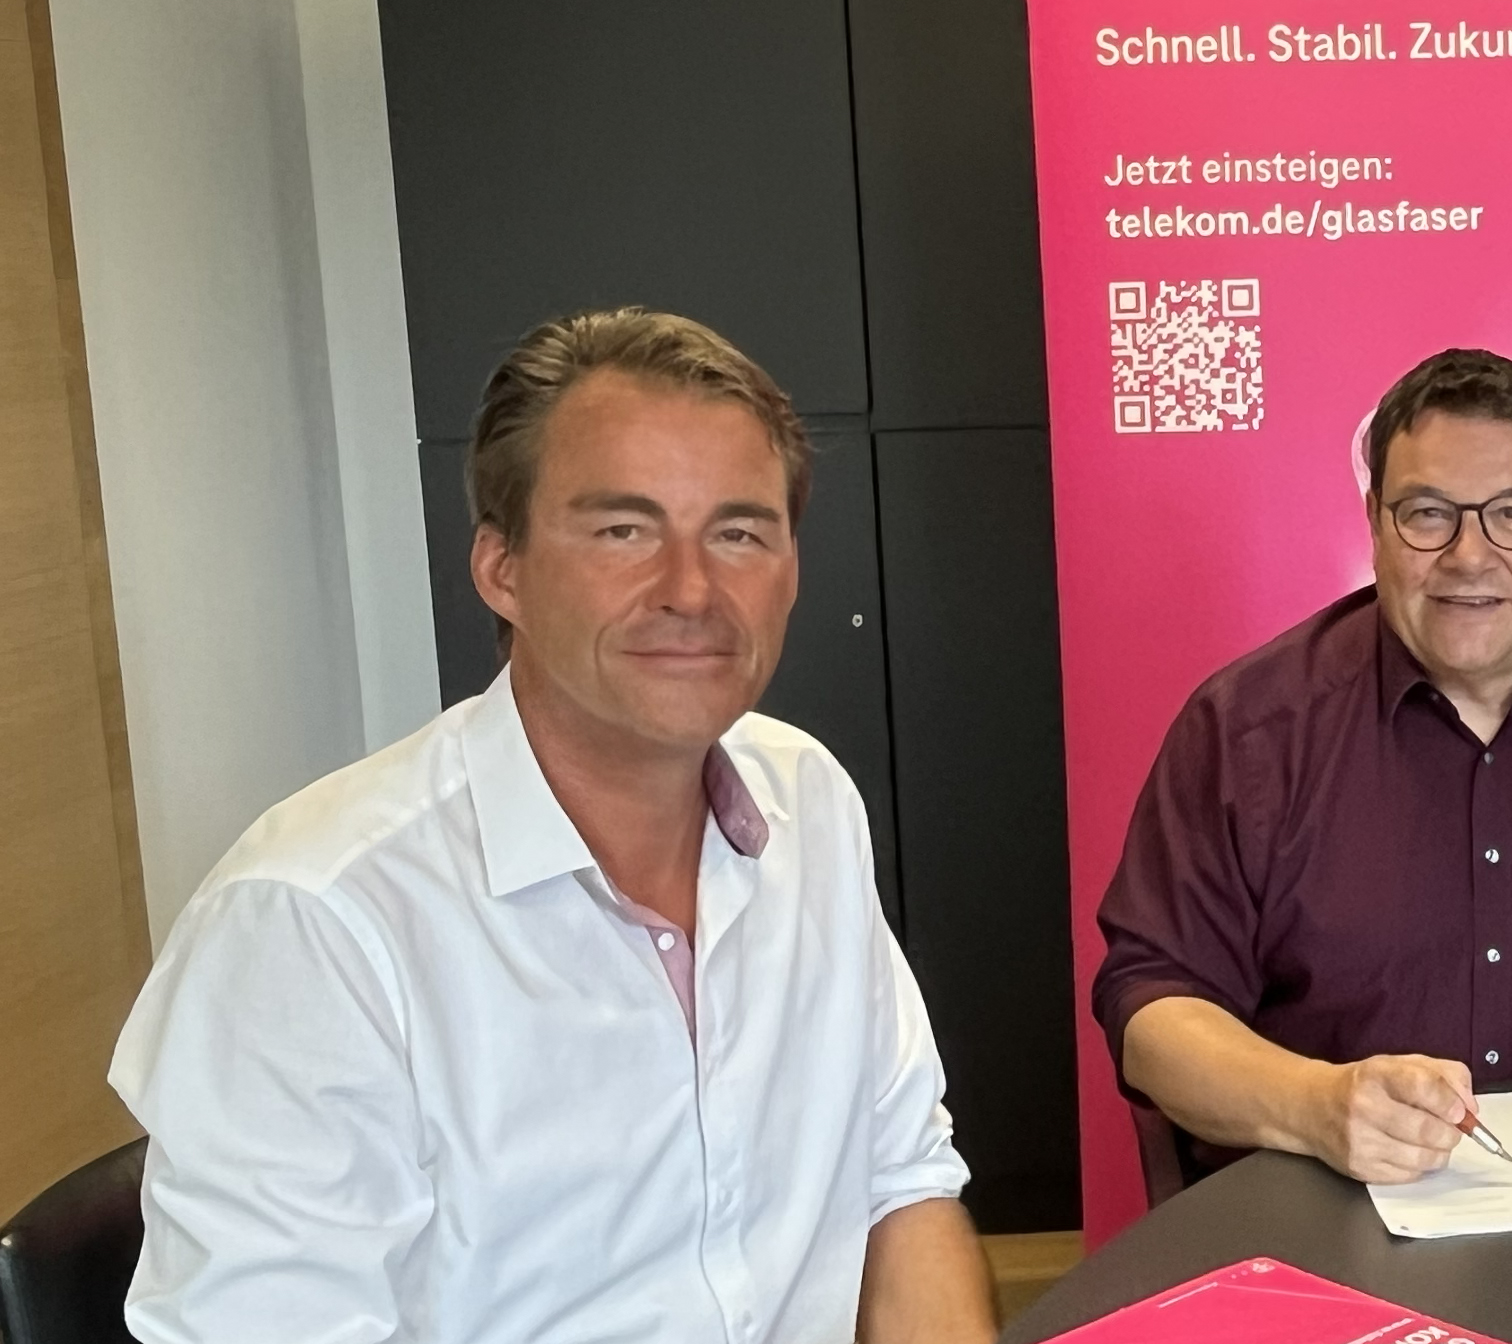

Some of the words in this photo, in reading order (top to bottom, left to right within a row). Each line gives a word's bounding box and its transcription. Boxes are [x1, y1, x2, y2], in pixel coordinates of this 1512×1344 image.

[1096, 25, 1256, 66] Schnell.
[1268, 23, 1397, 62] Stabil.
[1104, 154, 1193, 187] Jetzt
[1202, 150, 1393, 188] einsteigen:
[1105, 199, 1484, 241] telekom.de/glasfaser
